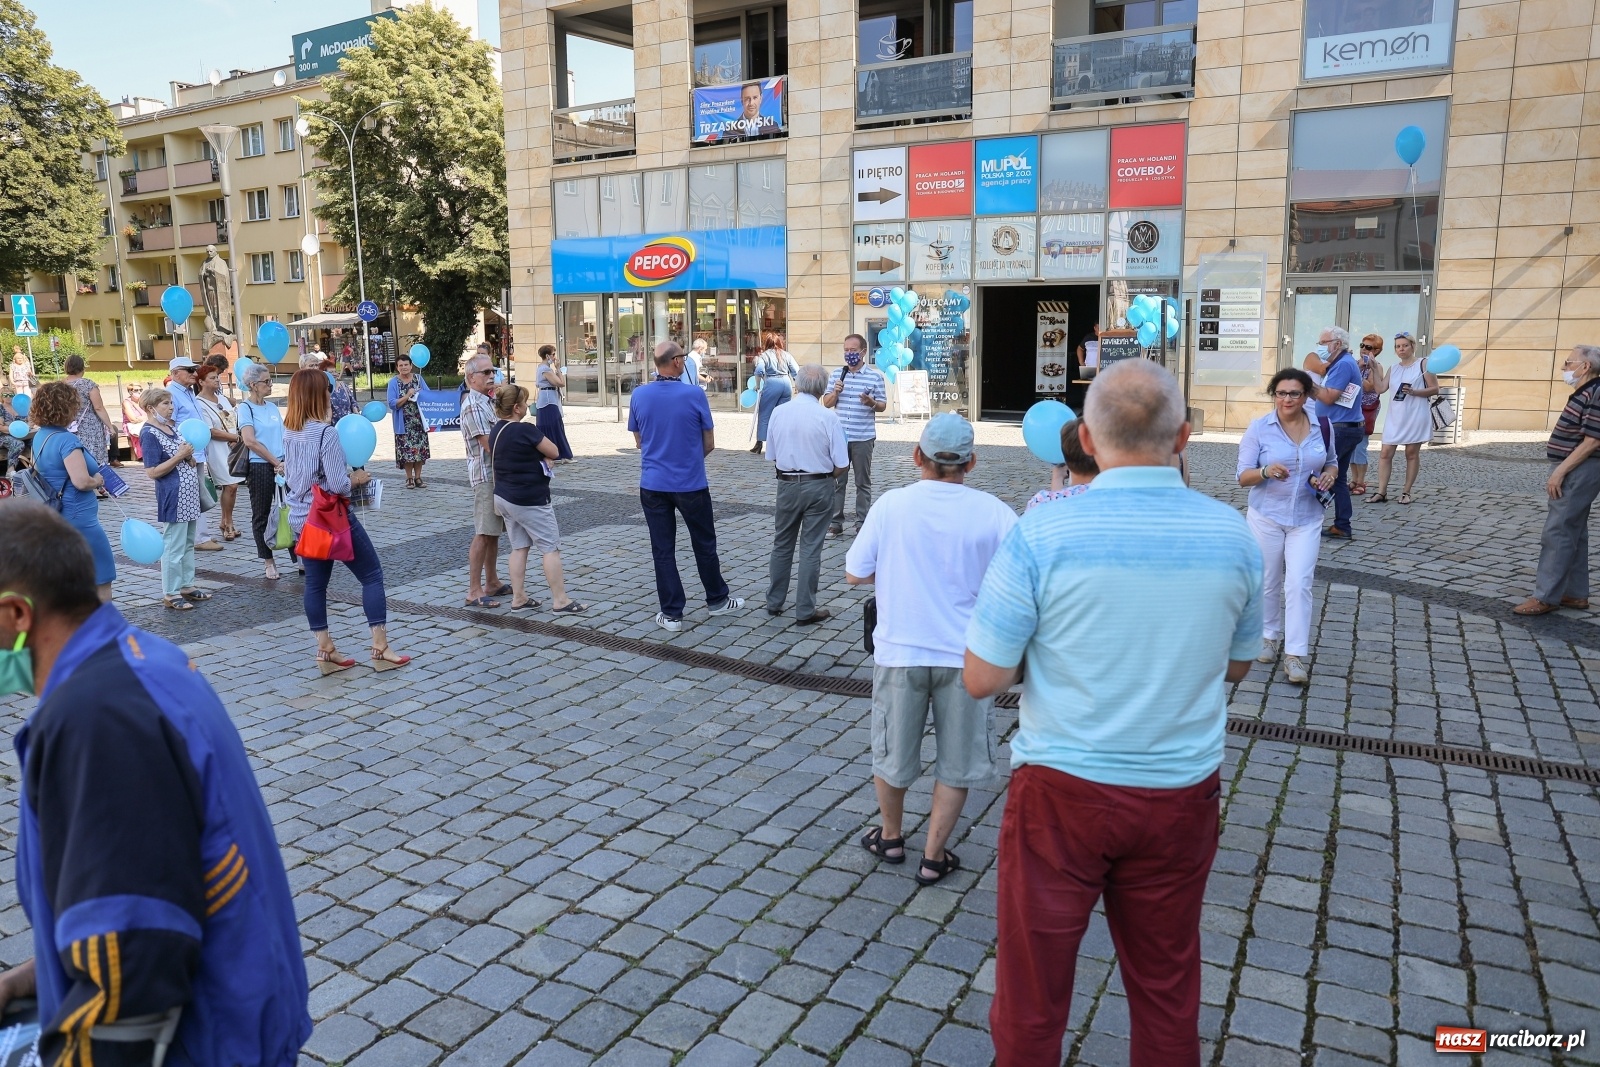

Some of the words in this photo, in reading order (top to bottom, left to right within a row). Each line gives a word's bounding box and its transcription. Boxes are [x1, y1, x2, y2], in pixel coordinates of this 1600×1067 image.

[320, 33, 375, 58] McDonald's
[298, 63, 311, 72] 300
[311, 62, 319, 70] m
[700, 116, 774, 134] TRZASKOWSKI
[981, 156, 1032, 173] MUPOL
[1117, 165, 1164, 177] COVEBO
[867, 166, 903, 180] PIĘTRO
[981, 172, 1005, 180] POLSKA
[915, 180, 955, 191] COVEBO
[981, 179, 1009, 188] agencja
[1010, 178, 1032, 186] pracy
[864, 234, 905, 249] PIĘTRO
[634, 253, 683, 270] PEPCO
[1126, 256, 1158, 264] FRYZJER
